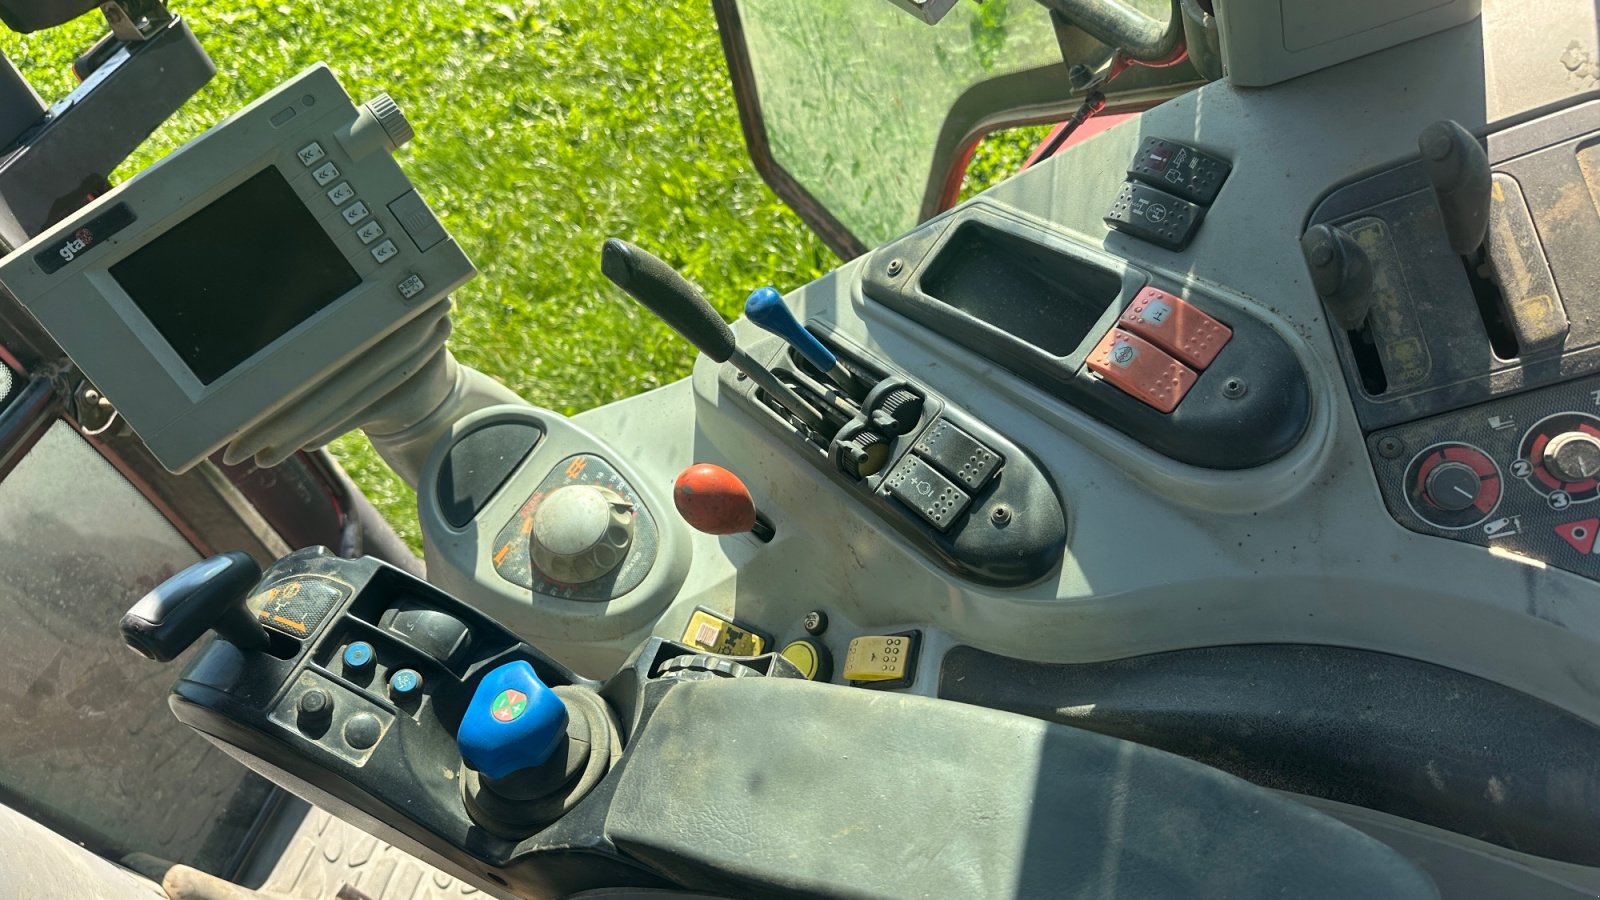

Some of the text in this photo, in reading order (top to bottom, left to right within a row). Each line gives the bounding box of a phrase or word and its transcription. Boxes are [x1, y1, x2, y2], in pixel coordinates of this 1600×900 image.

[59, 239, 86, 262] gta
[403, 275, 419, 289] ESC
[1514, 462, 1529, 476] 2
[1551, 493, 1567, 507] 3
